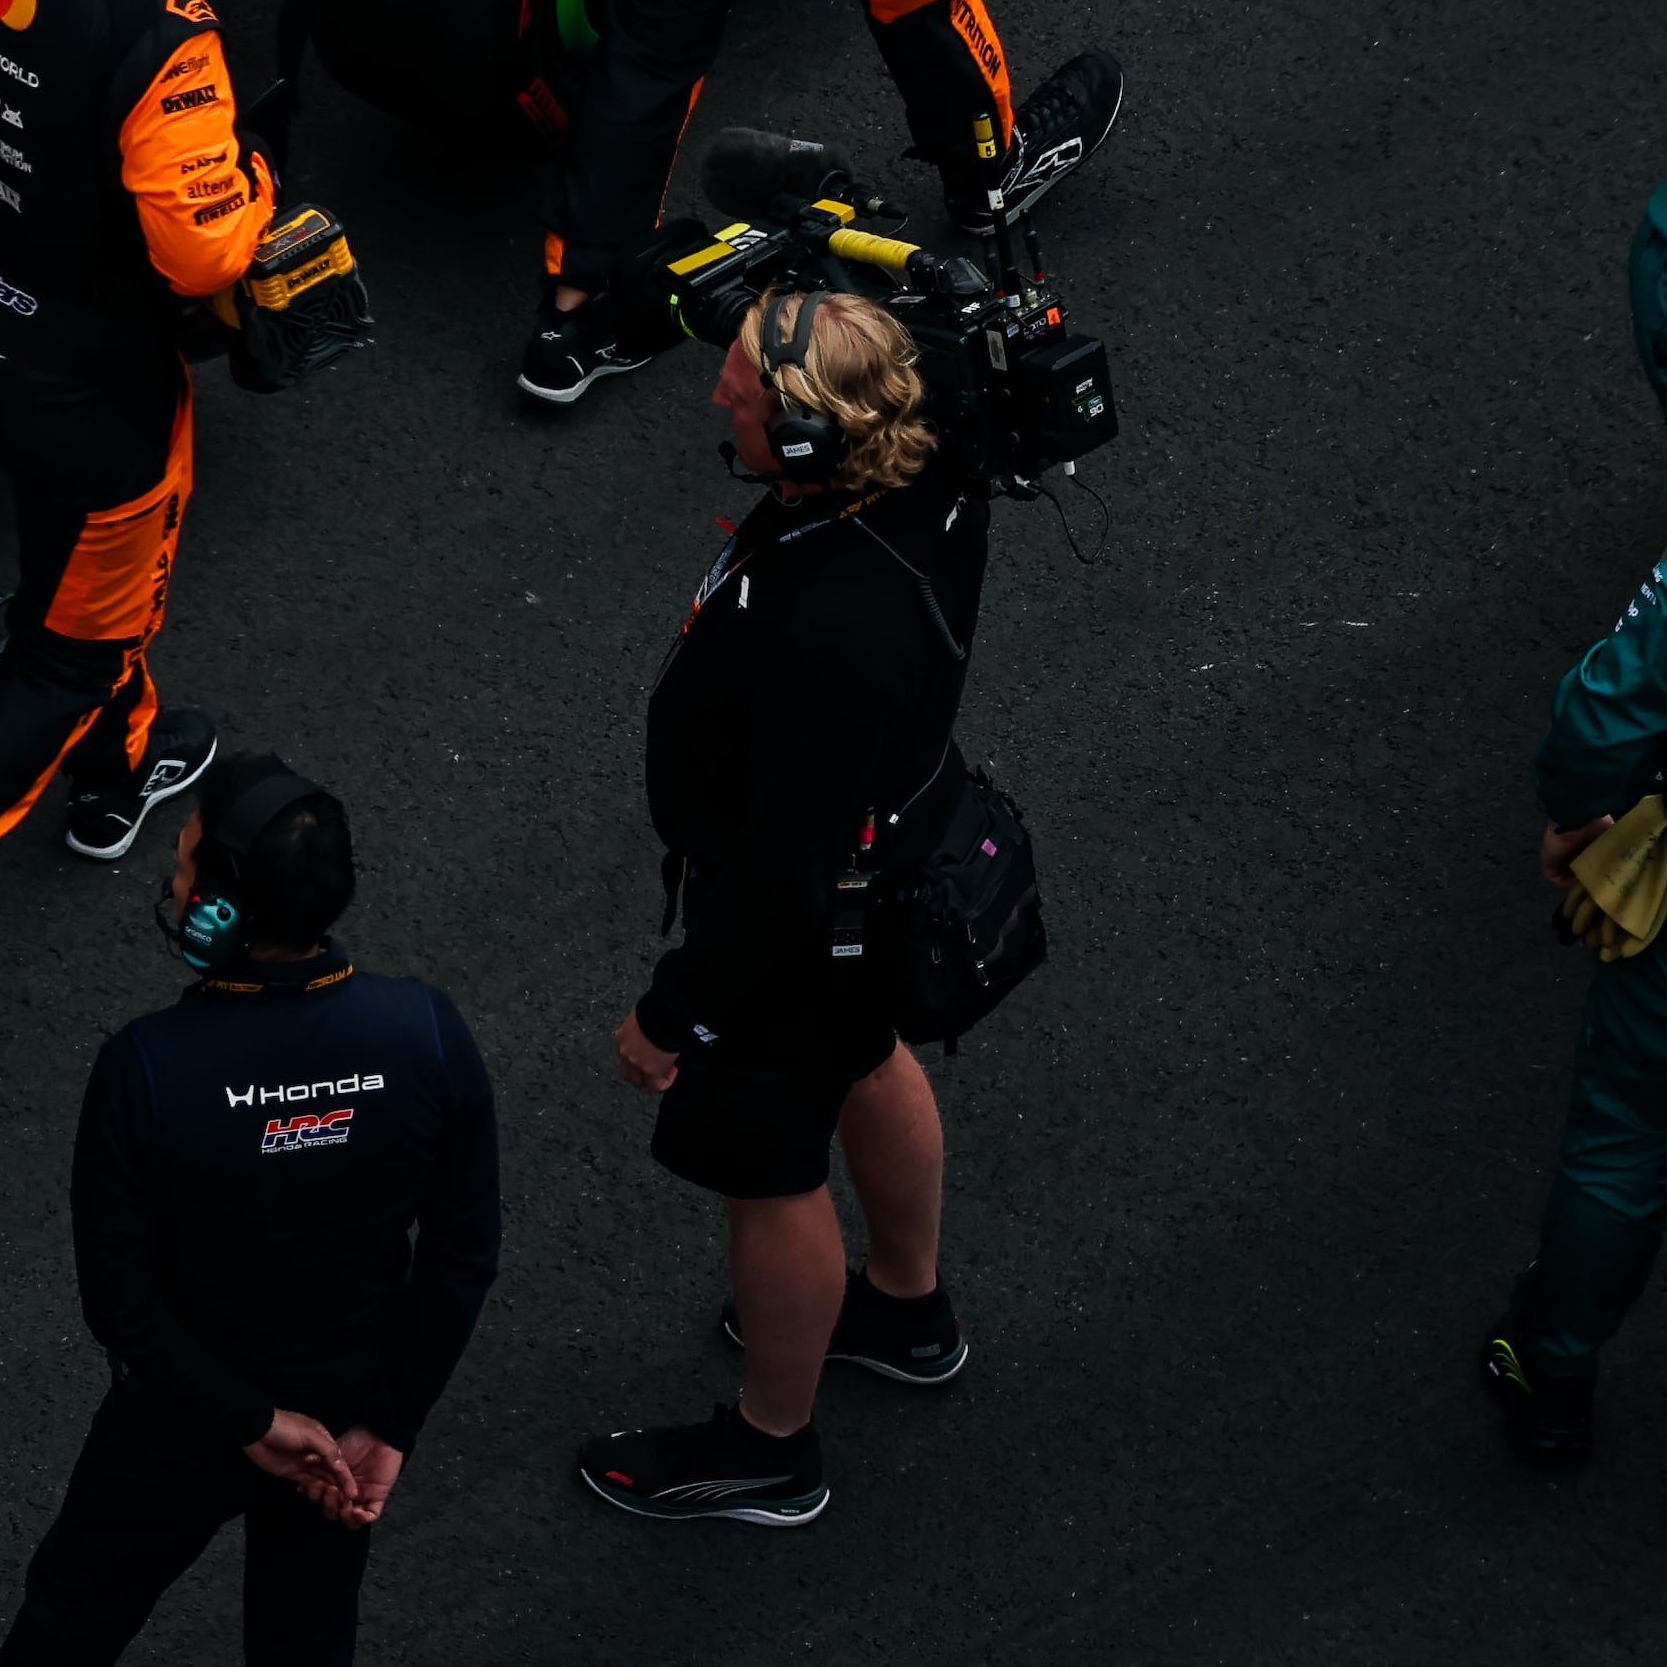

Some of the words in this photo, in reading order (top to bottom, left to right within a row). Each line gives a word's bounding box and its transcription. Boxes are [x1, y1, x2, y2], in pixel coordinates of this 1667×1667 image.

[260, 1072, 385, 1104] Honda
[261, 1108, 354, 1145] HRC
[261, 1143, 303, 1155] Honda
[303, 1135, 349, 1150] RACING
